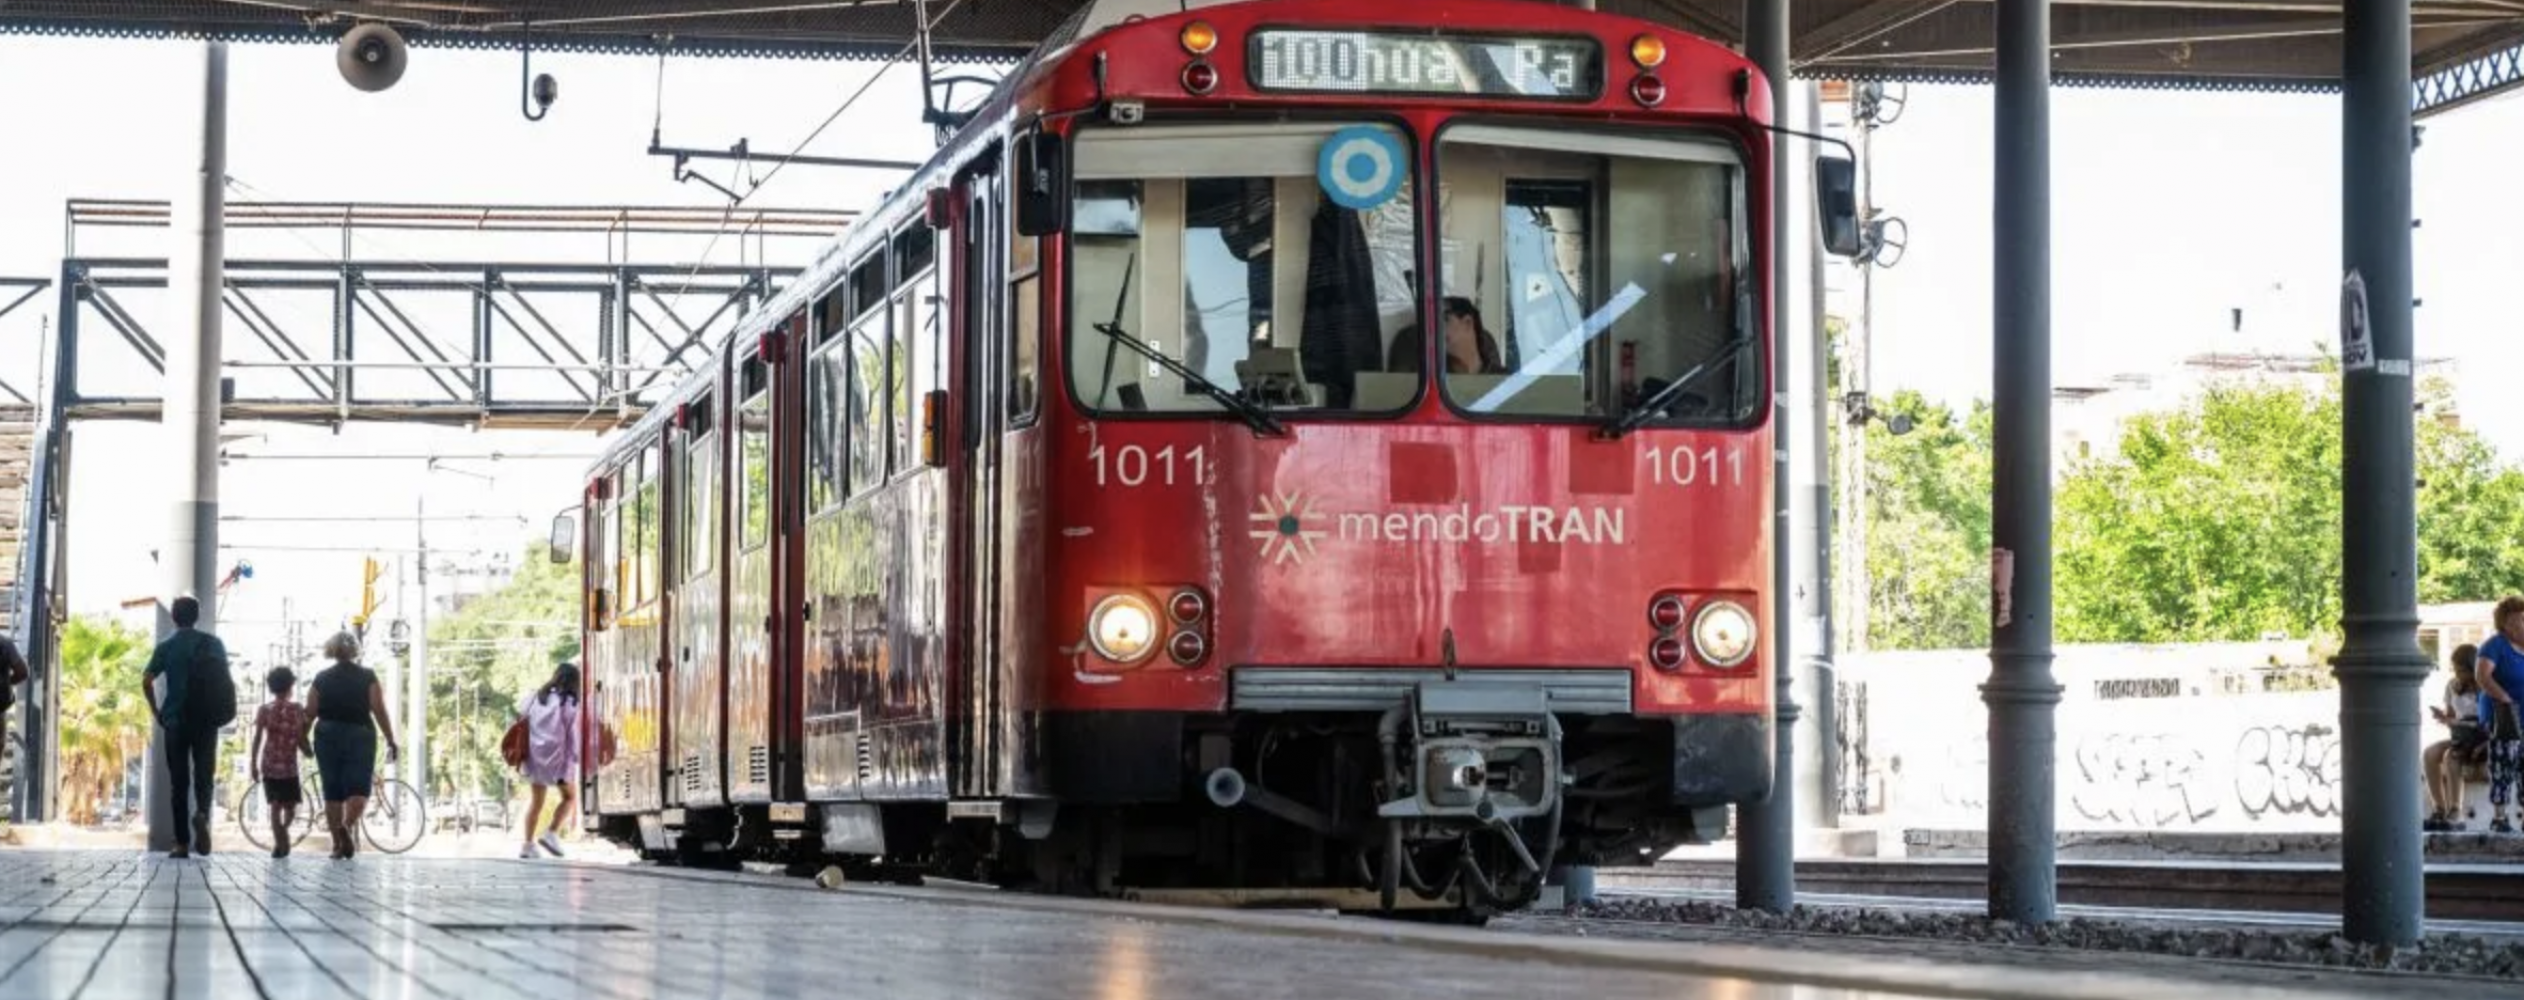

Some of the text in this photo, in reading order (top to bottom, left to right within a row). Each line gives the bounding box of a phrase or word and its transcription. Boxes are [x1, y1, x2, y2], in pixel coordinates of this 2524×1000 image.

[1514, 42, 1573, 88] Pa
[1088, 444, 1203, 487] 1011
[1645, 445, 1742, 486] 1011
[1338, 502, 1625, 544] mendoTRAN
